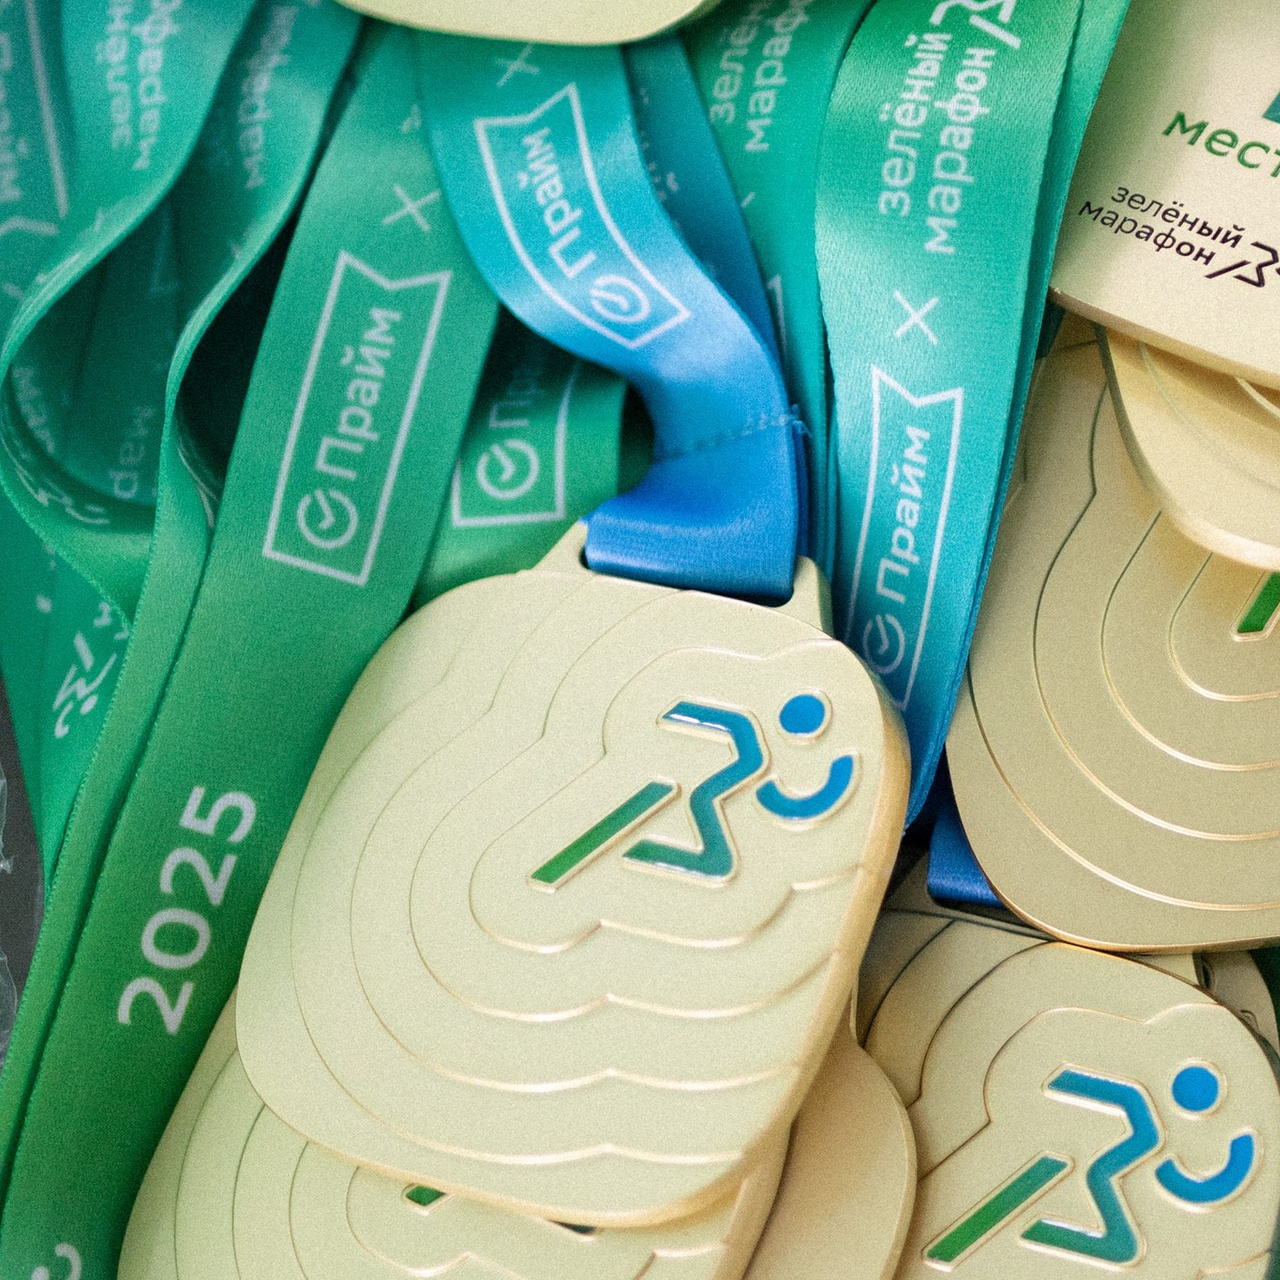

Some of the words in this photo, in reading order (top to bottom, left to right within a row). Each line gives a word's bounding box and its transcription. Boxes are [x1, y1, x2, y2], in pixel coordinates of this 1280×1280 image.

[516, 126, 598, 280] Прайм
[876, 31, 953, 219] зелёный
[923, 47, 998, 256] марафон
[1076, 197, 1218, 268] марафон
[1110, 184, 1245, 251] зелёный
[313, 306, 403, 481] Прайм
[873, 425, 932, 610] Прайм
[113, 784, 258, 1037] 2025
